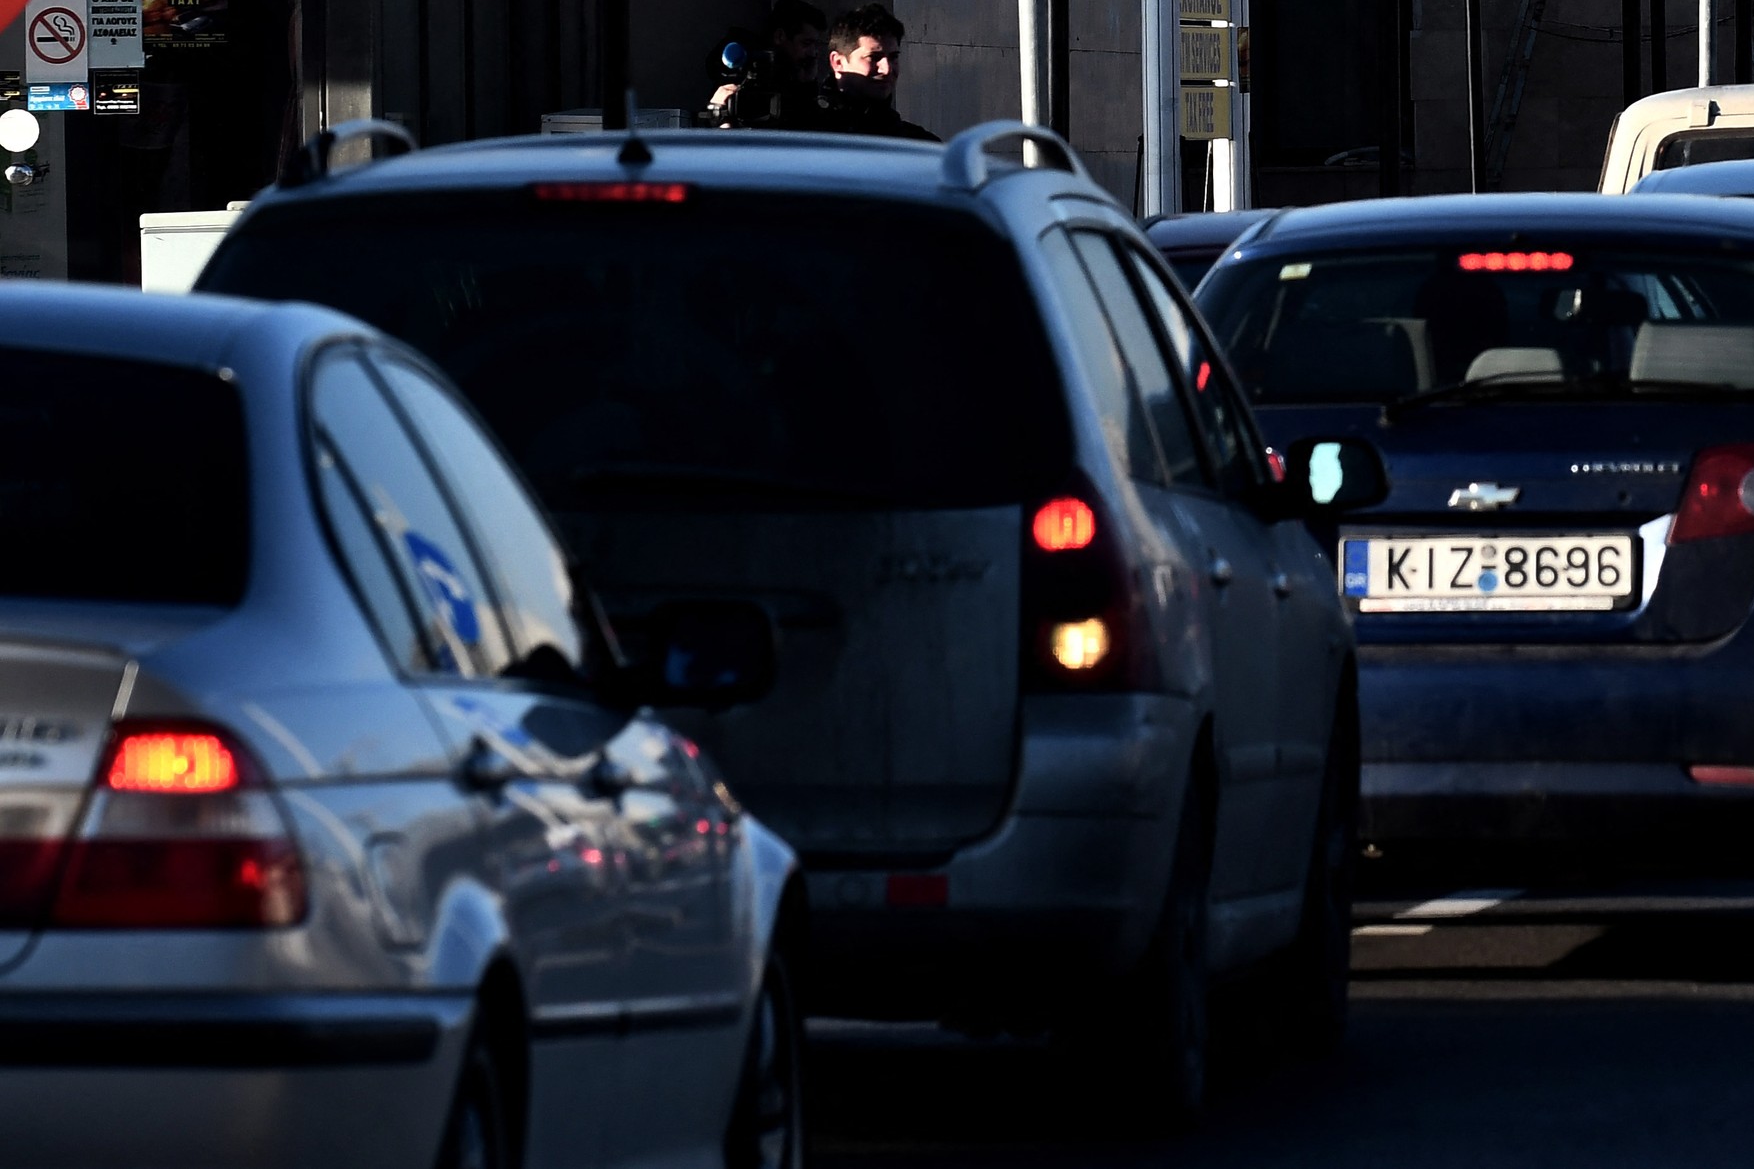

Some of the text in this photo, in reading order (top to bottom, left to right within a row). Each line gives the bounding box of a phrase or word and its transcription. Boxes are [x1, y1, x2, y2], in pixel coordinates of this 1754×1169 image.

[93, 28, 137, 37] ΑΣΦΑΛΕΙΑΣ
[106, 17, 137, 26] ΛΟΓΟΥΣ
[1192, 32, 1221, 73] SERVICES
[1185, 92, 1214, 132] TAX FREE
